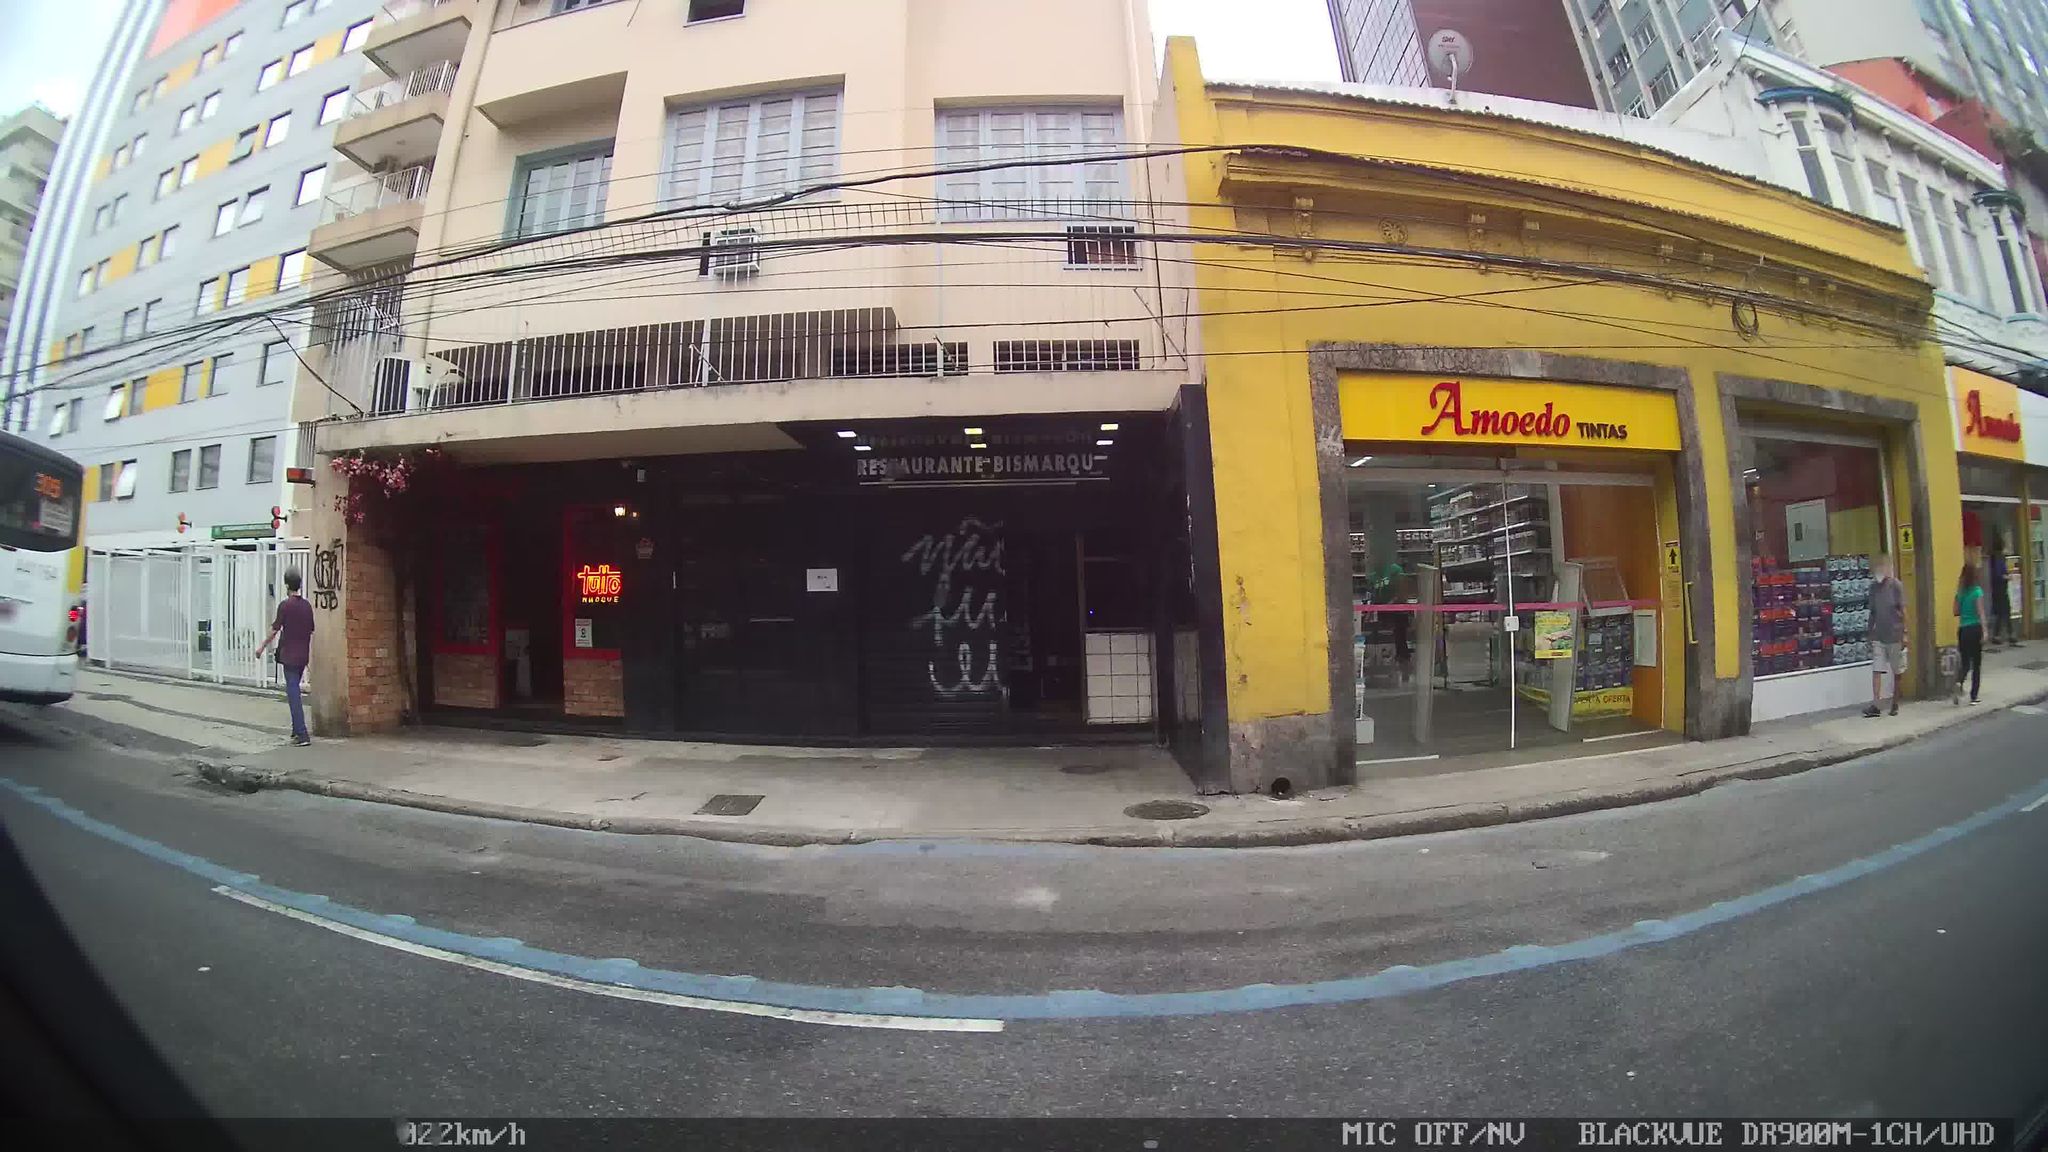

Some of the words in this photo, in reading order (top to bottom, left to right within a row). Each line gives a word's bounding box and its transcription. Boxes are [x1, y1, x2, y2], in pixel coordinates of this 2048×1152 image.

[1421, 381, 1571, 438] Amoedo
[1576, 421, 1628, 440] TINTAS
[857, 455, 984, 476] RESAURANTE
